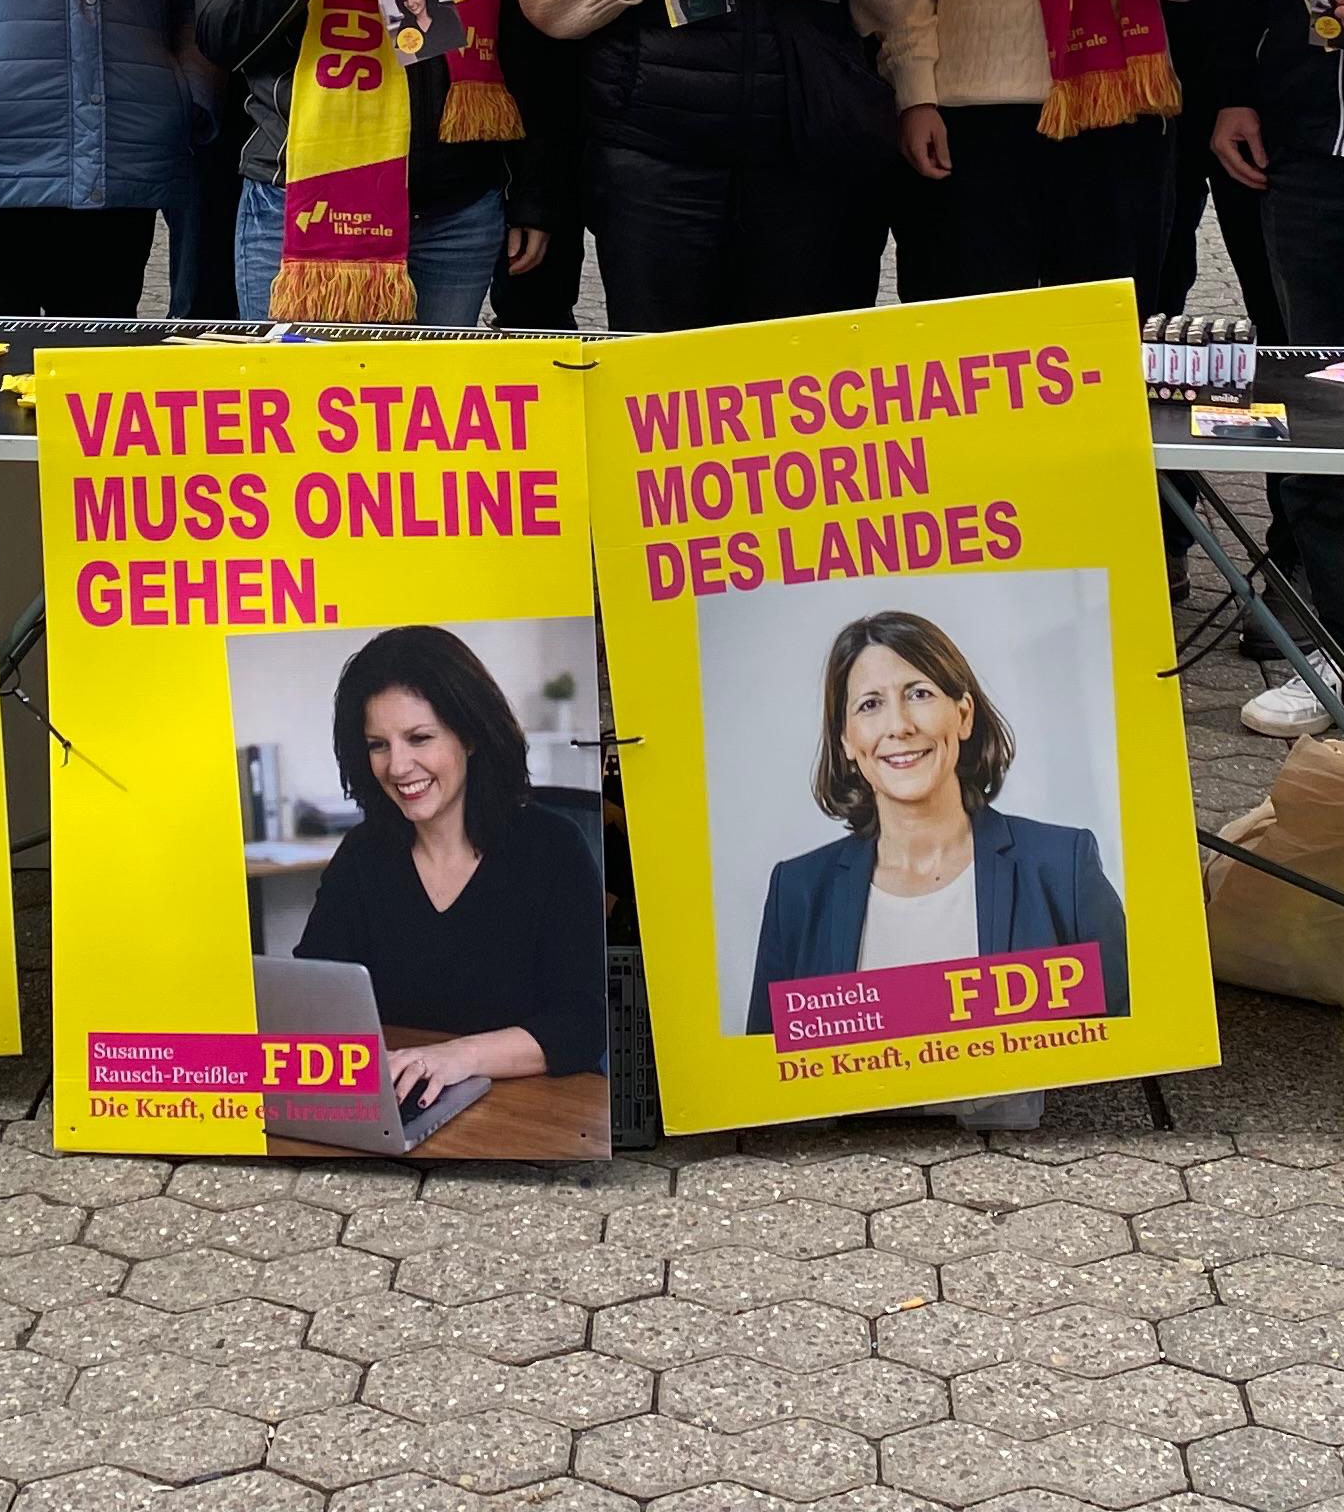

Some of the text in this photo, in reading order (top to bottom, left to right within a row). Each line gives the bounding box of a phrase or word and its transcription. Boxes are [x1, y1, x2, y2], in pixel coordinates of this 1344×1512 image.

[328, 207, 372, 225] junge
[333, 221, 394, 238] liberale
[66, 385, 538, 457] VATER STAAT
[626, 345, 1101, 453] WIRTSCHAFTS-
[74, 470, 561, 542] MUSS ONLINE
[636, 437, 929, 528] MOTORIN
[646, 501, 1022, 601] DES LANDES
[76, 558, 338, 627] GEHEN.
[786, 983, 880, 1013] Daniela
[944, 956, 1085, 1021] FDP
[93, 1042, 174, 1060] Susanne
[777, 1021, 1108, 1082] Die Kraft, die es braucht
[788, 1012, 885, 1041] Schmitt
[94, 1065, 249, 1085] Rausch-Preißler
[262, 1042, 371, 1086] FDP
[89, 1097, 128, 1119] Die
[135, 1097, 204, 1123] Kraft,
[212, 1097, 249, 1119] die
[254, 1104, 276, 1119] es
